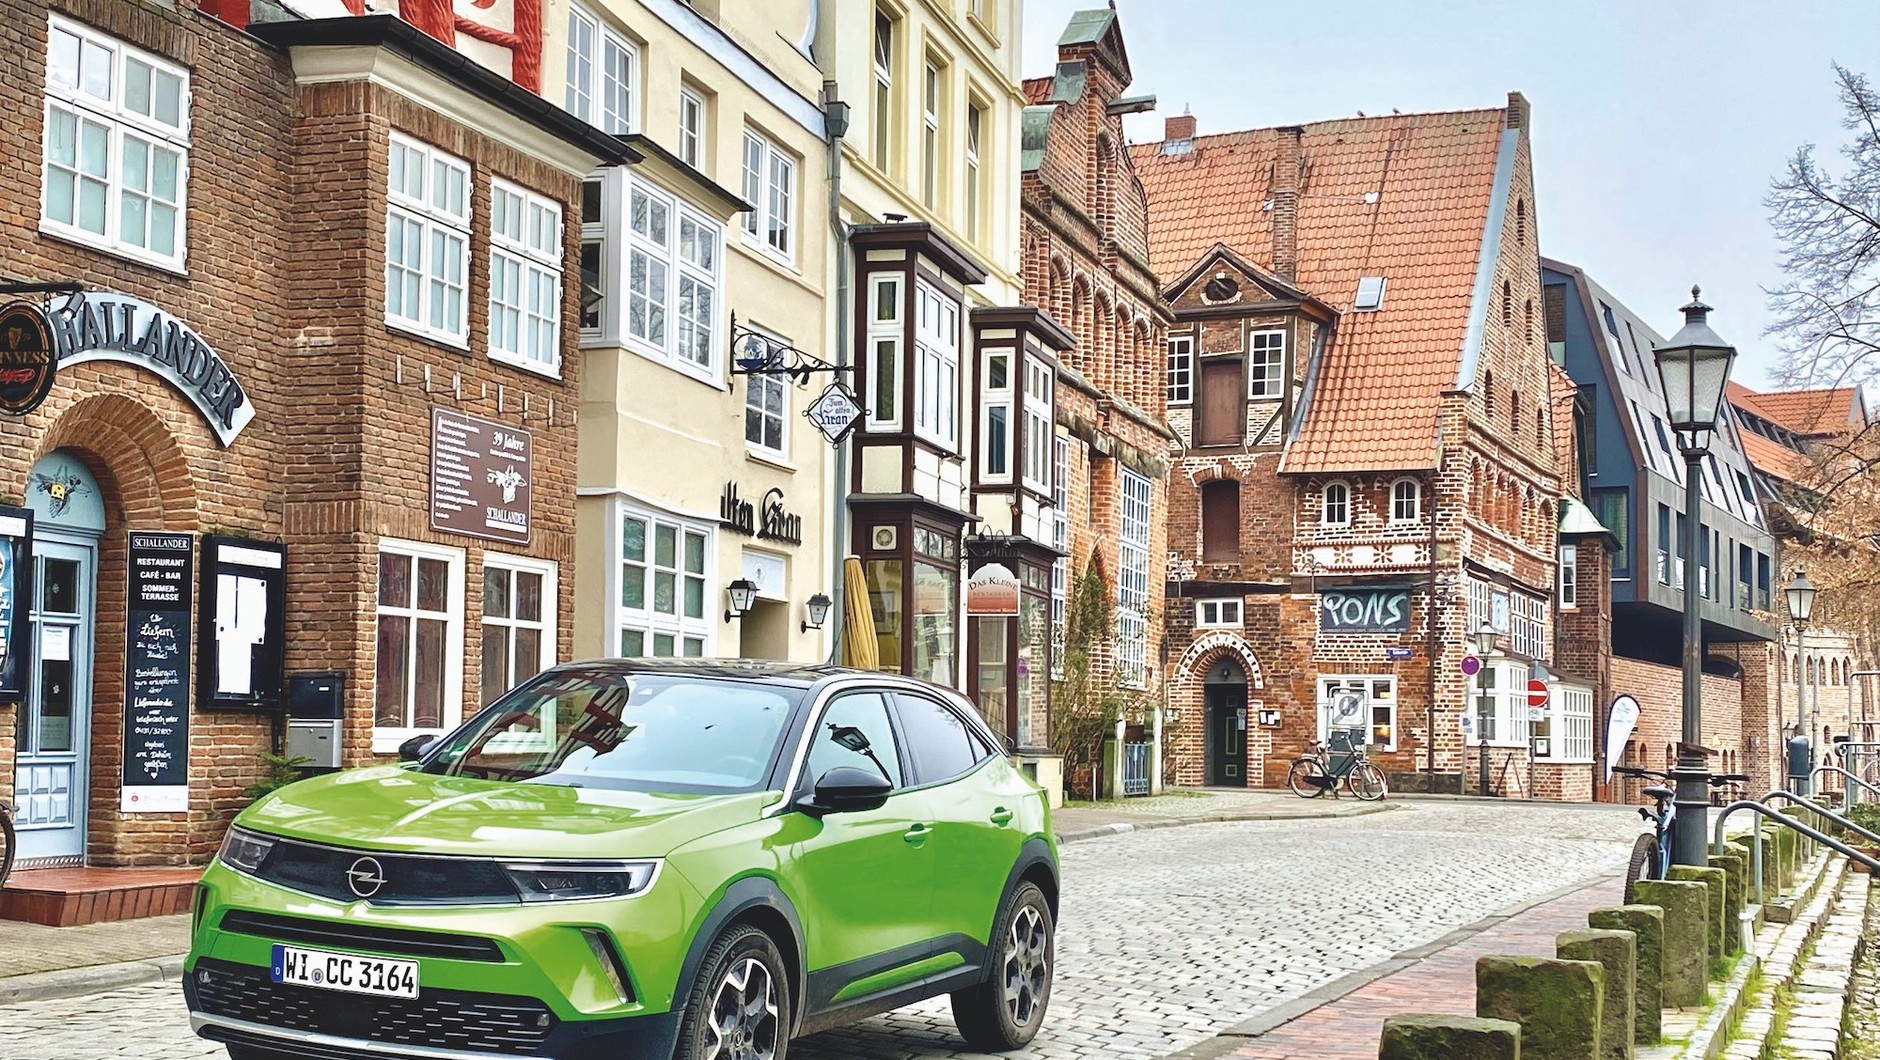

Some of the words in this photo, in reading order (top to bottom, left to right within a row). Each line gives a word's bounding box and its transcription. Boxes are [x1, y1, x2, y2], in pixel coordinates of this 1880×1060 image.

[492, 431, 503, 447] 39
[503, 433, 525, 452] Jahre
[134, 538, 188, 549] SCHALLANDER
[136, 558, 185, 568] RESTAURANT
[140, 570, 160, 580] CAFÉ
[165, 572, 181, 580] BAR
[141, 584, 179, 593] SOMMER-
[140, 592, 180, 601] TERRASSE
[1323, 592, 1407, 627] PONS
[285, 951, 309, 981] WI
[326, 957, 353, 986] CC
[359, 961, 415, 994] 3164
